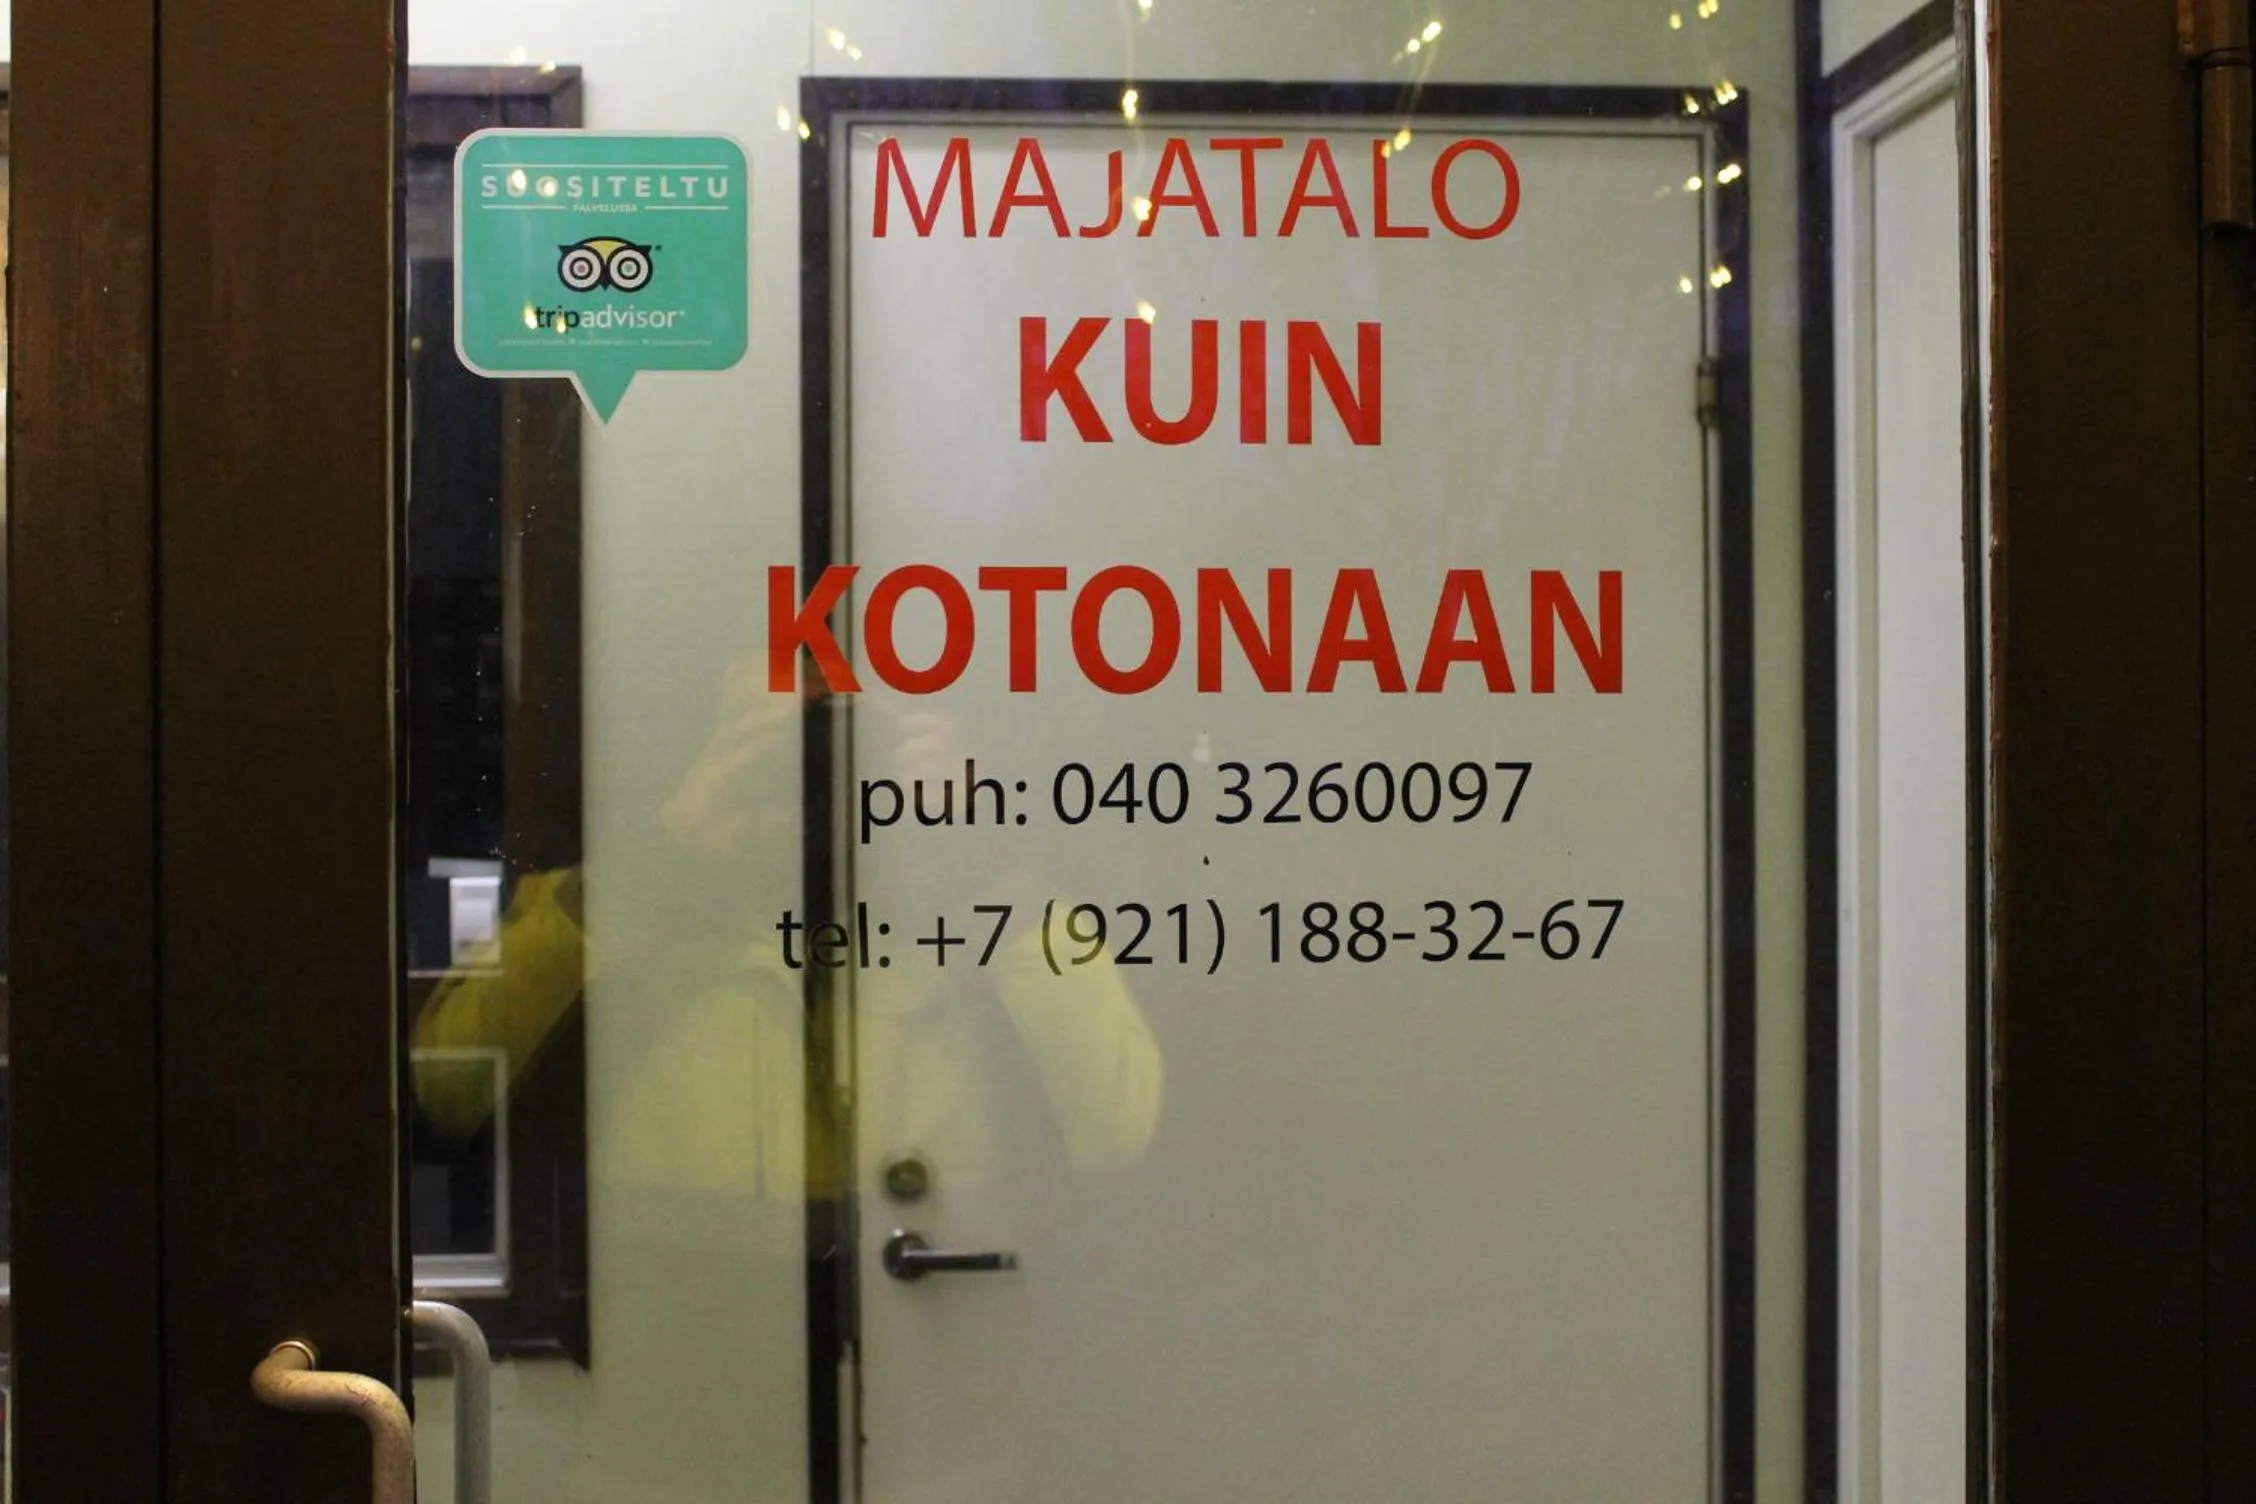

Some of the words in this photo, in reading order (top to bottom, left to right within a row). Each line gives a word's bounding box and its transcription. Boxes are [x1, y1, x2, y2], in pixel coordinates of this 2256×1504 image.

[481, 175, 728, 198] SUOSITELTU
[872, 137, 1520, 240] MAJATALO
[1020, 316, 1382, 446] KUIN
[767, 564, 1624, 695] KOTONAAN
[860, 759, 1028, 845] puh:
[1052, 762, 1190, 825] 040
[1215, 761, 1533, 825] 3260097
[775, 901, 891, 970] tel:
[916, 905, 1013, 967] +7
[1041, 899, 1225, 976] (921)
[1259, 899, 1625, 964] 188-32-67
